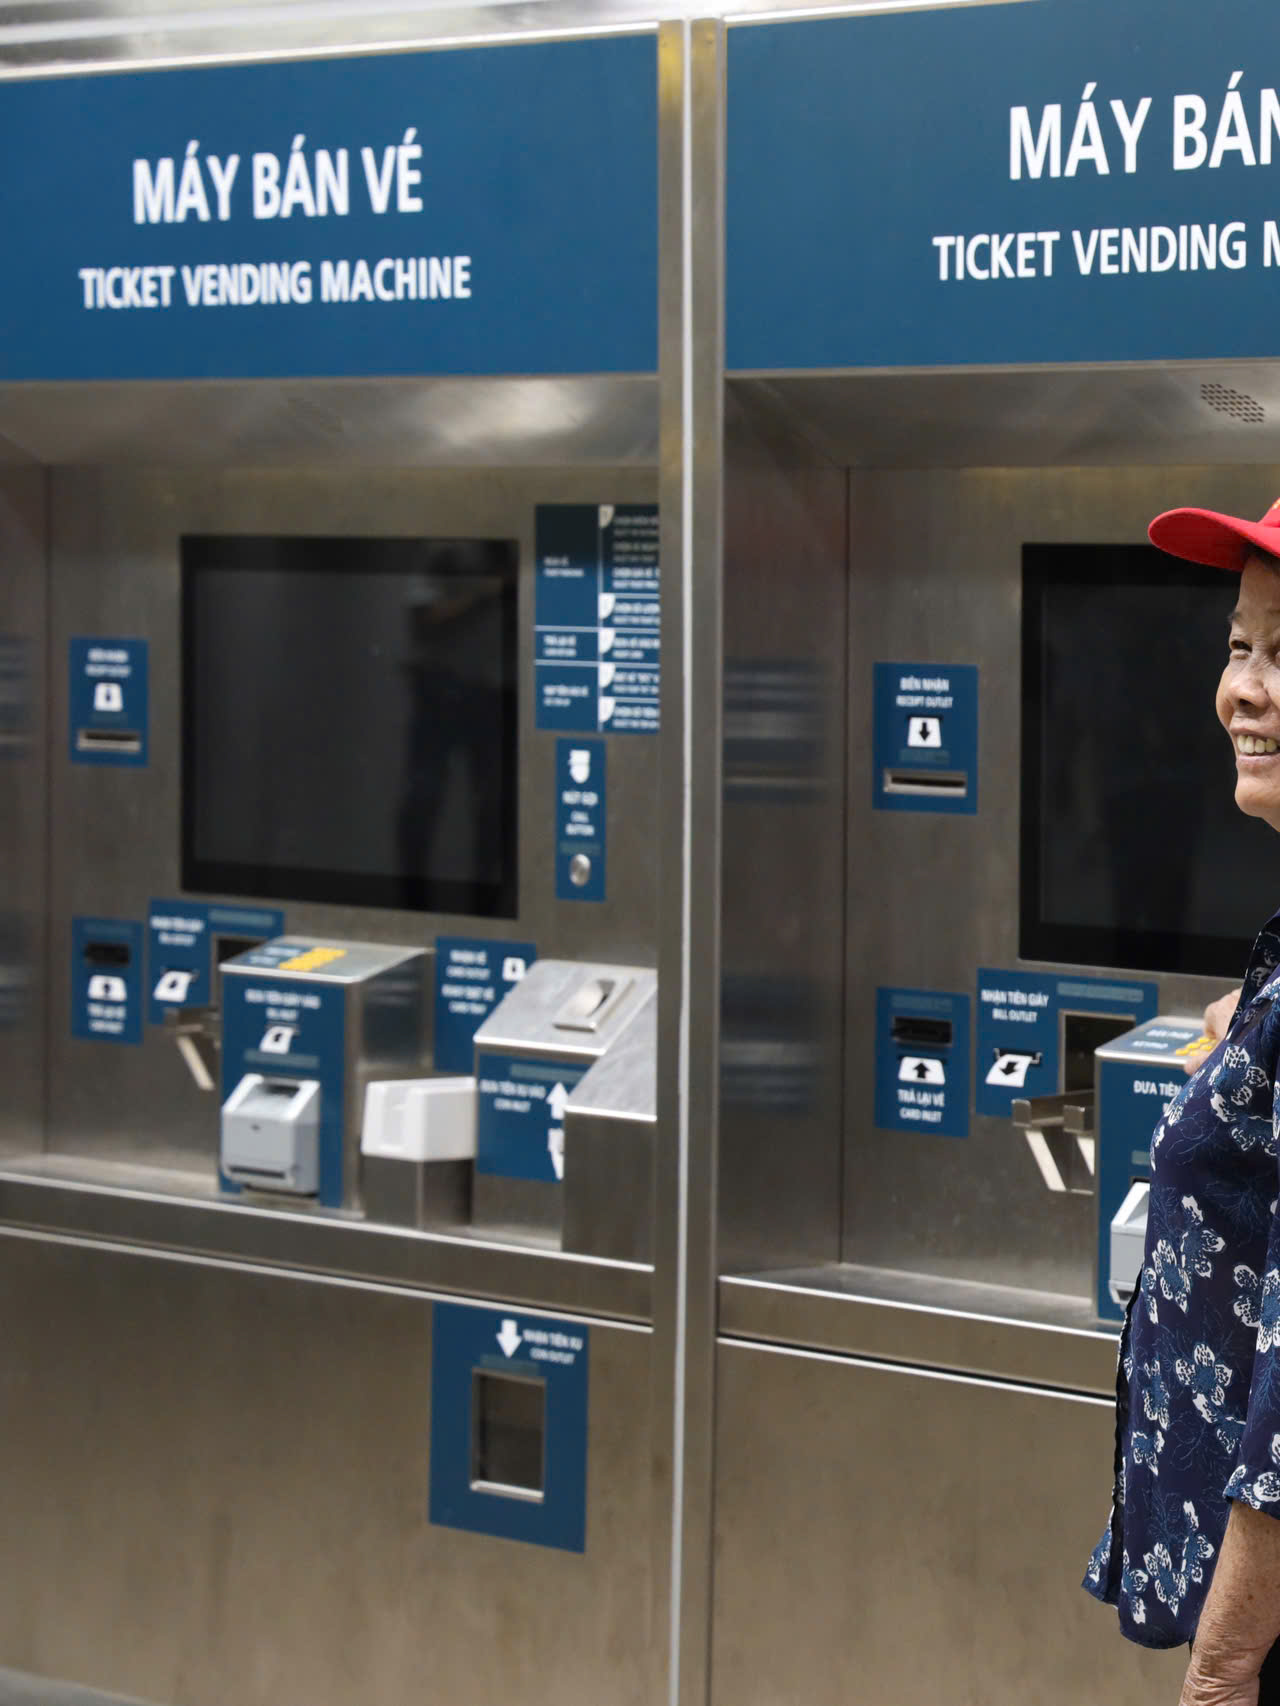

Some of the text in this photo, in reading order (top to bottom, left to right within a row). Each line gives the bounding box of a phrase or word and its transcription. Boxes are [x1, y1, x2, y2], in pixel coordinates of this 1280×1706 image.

[1009, 81, 1152, 181] MÁY
[132, 127, 424, 224] MÁY BÁN VÉ
[79, 255, 472, 309] TICKET VENDING MACHINE
[933, 231, 1060, 281] TICKET
[1071, 222, 1247, 276] VENDING
